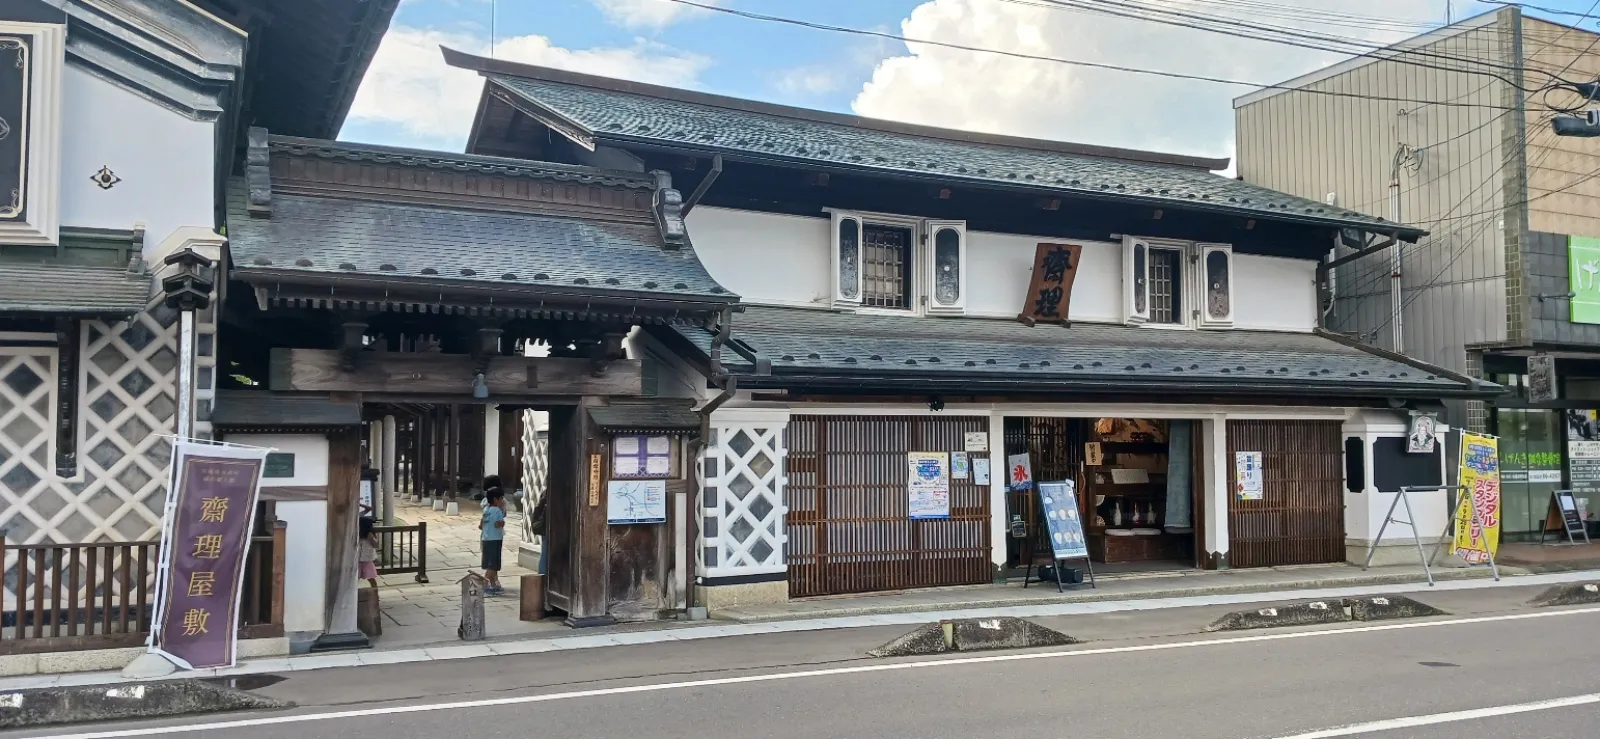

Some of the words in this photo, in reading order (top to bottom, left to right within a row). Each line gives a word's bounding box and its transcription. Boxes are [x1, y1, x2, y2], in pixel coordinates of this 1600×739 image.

[1033, 245, 1073, 318] 齋理
[1575, 257, 1600, 293] げ
[1013, 464, 1029, 482] 氷
[1483, 480, 1498, 527] デジタル
[182, 496, 229, 637] 齋理屋敷
[468, 579, 478, 597] 入口
